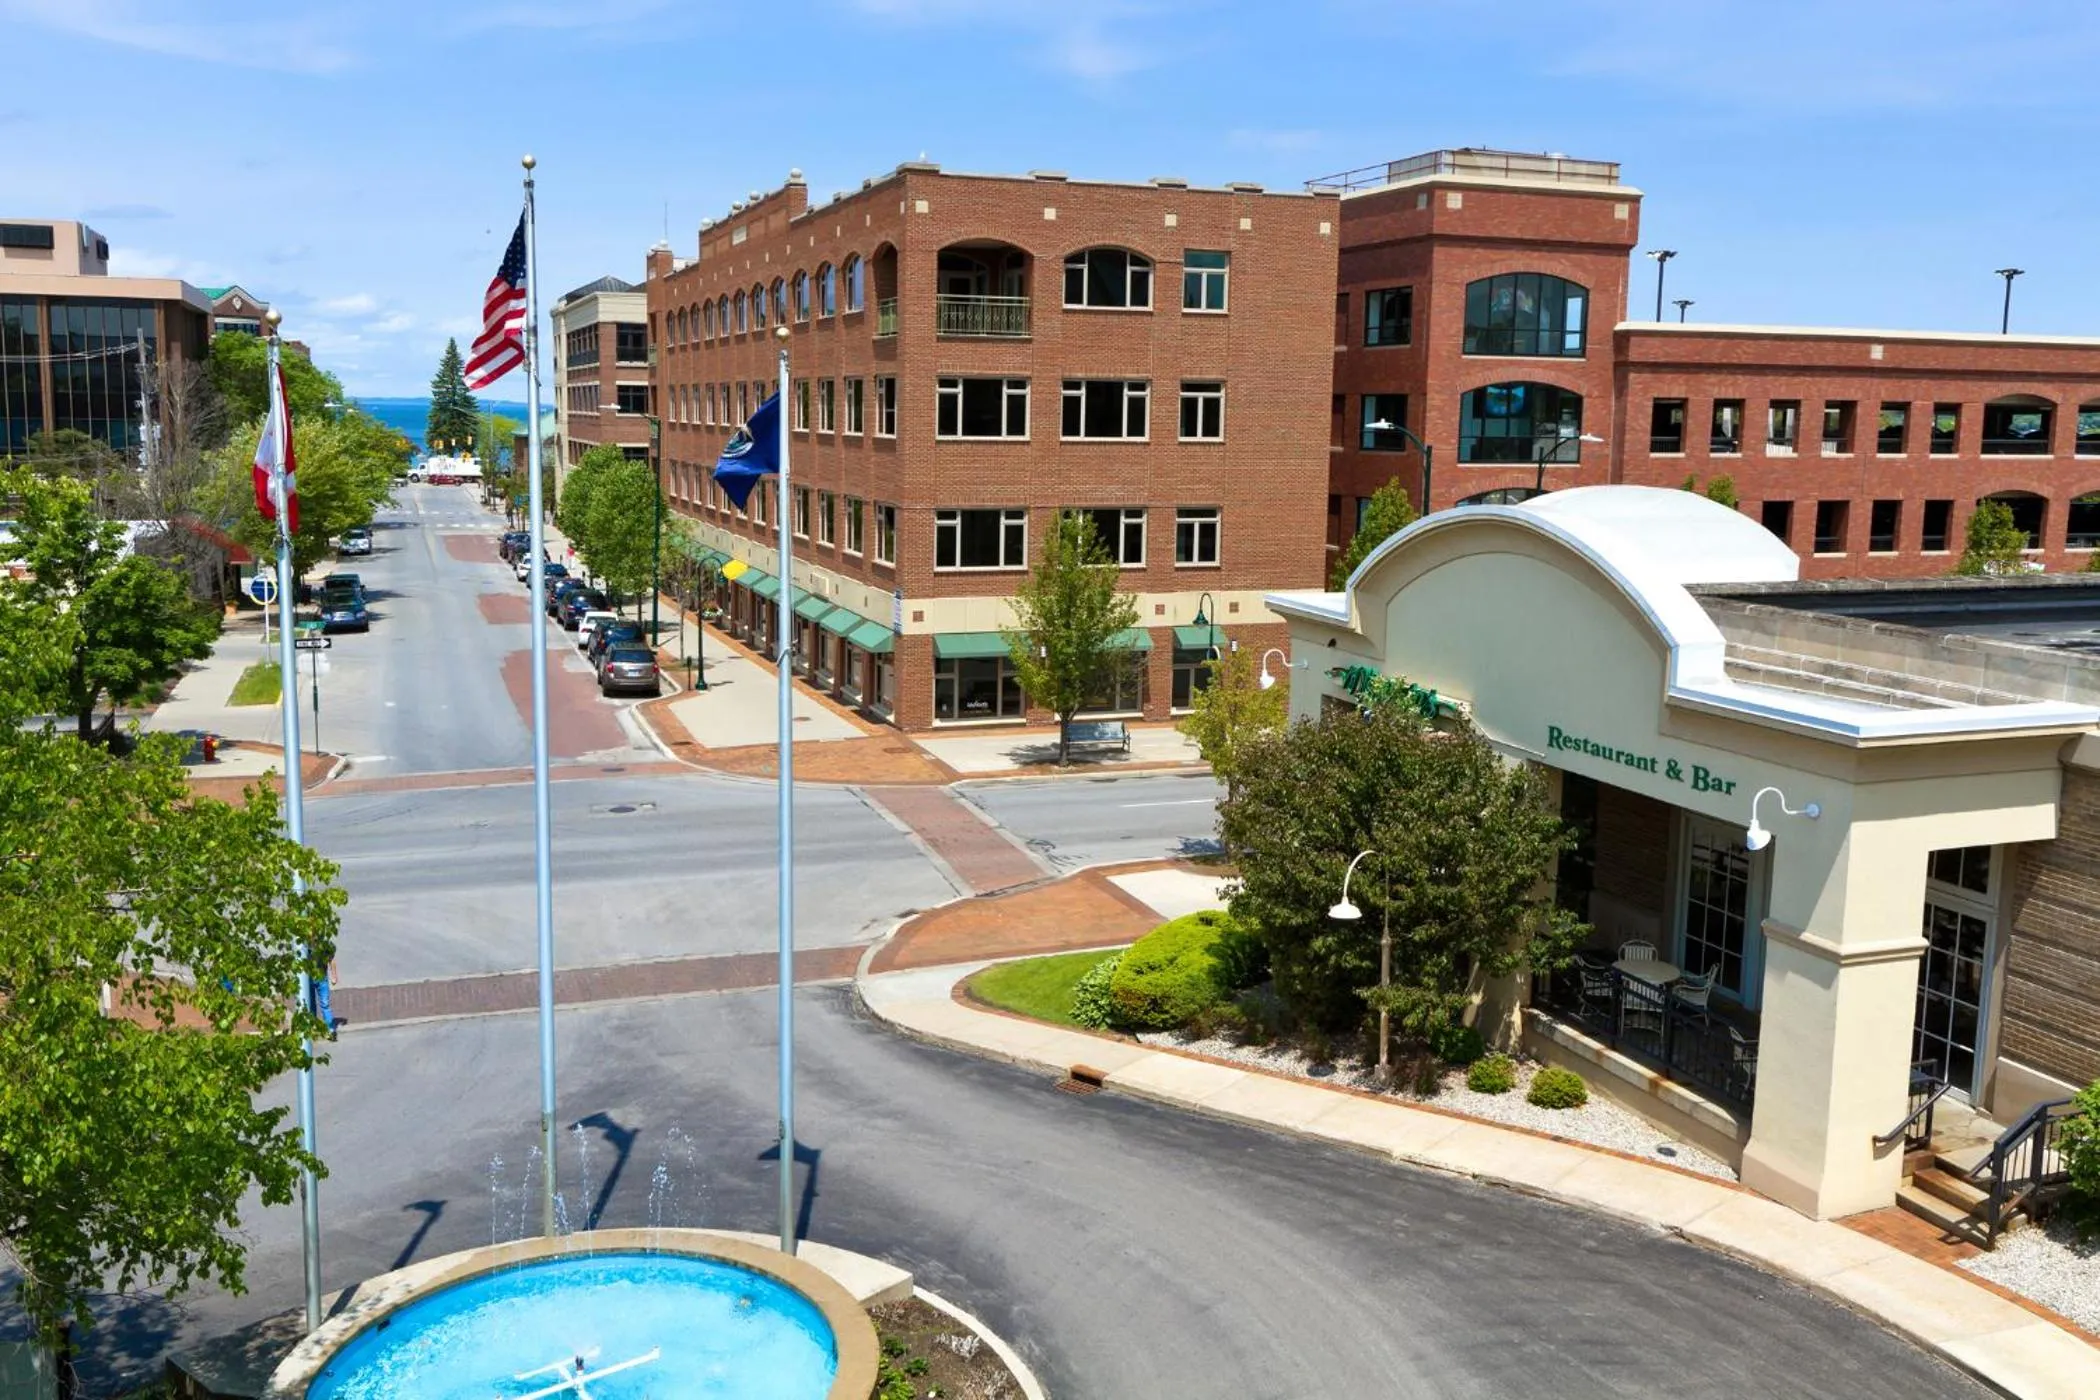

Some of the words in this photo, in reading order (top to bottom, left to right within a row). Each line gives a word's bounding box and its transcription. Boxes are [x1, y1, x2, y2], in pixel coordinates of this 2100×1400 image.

[1547, 725, 1659, 774] Restaurant
[1665, 759, 1685, 783] &
[1691, 764, 1737, 796] Bar
